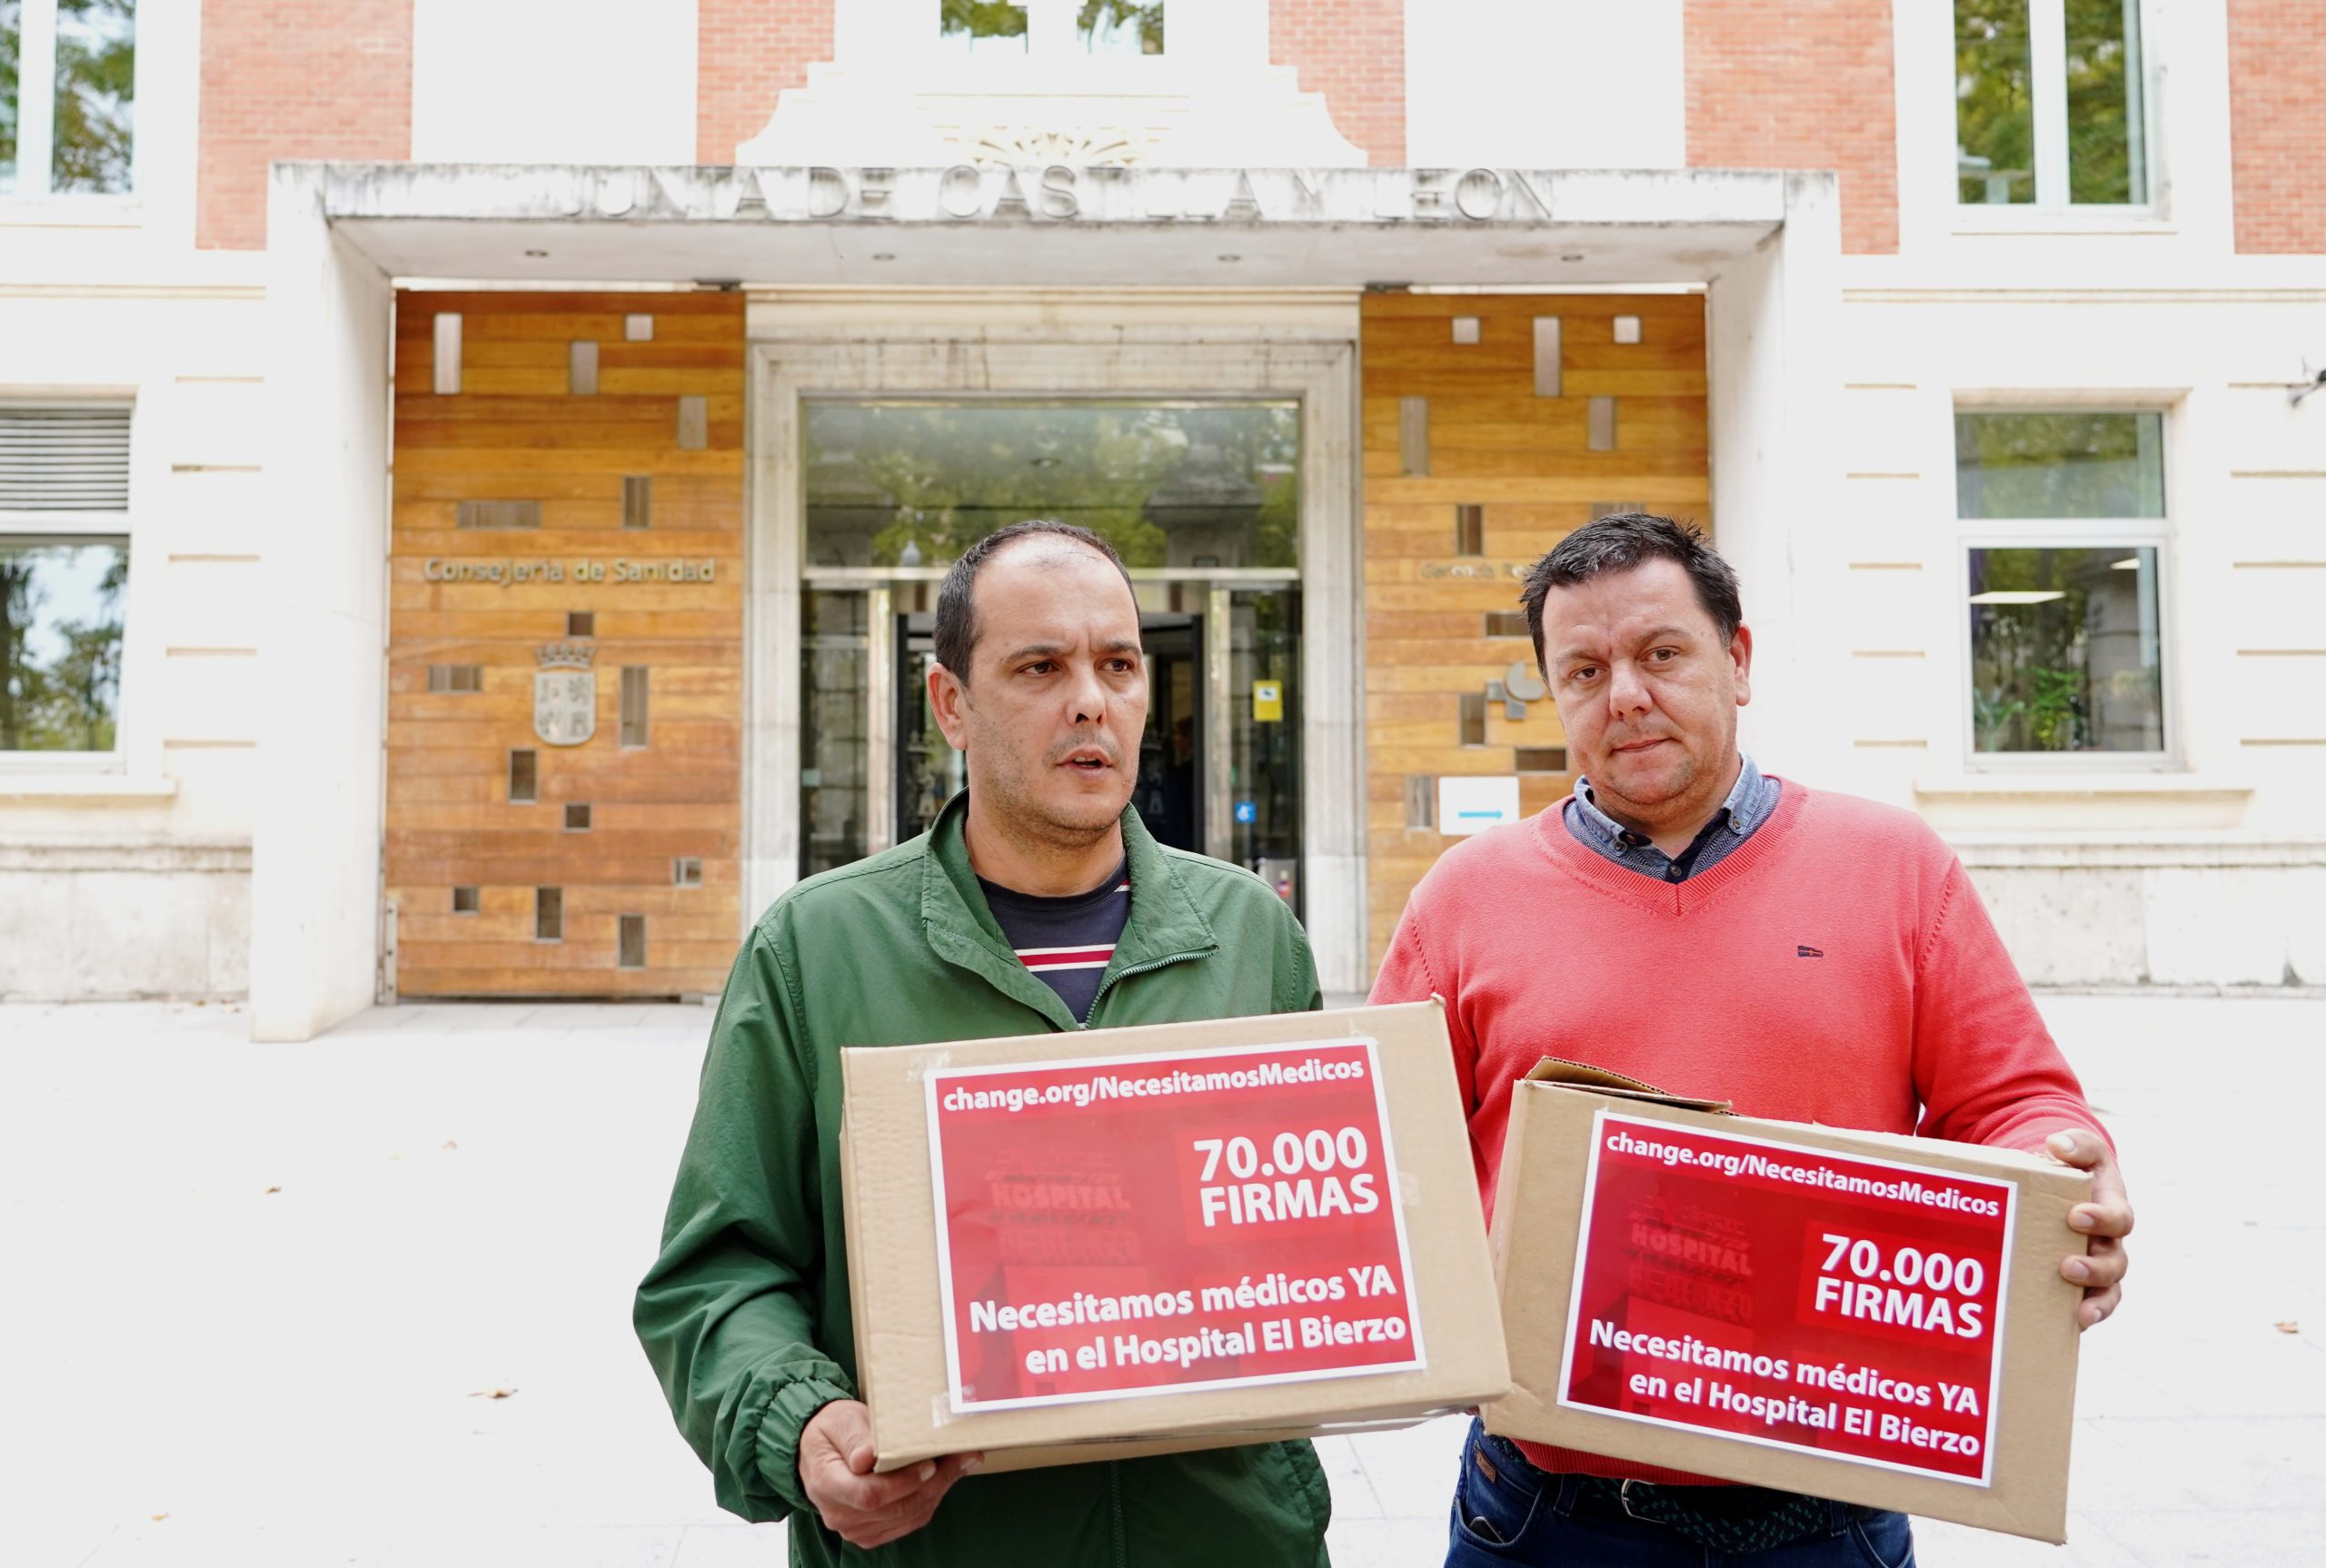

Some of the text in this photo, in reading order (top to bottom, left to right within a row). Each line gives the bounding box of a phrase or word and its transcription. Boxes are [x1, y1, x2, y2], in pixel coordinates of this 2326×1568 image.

[805, 165, 894, 219] DE
[573, 557, 605, 582] de
[612, 557, 715, 583] Sanidad
[943, 1058, 1365, 1113] change.org/NecesitamosMedicos
[1193, 1126, 1368, 1182] 70.000
[1606, 1131, 1999, 1216] change.org/NecesitamosMedicos
[989, 1183, 1131, 1210] HOSPITAL
[1199, 1173, 1379, 1227] FIRMAS
[1631, 1222, 1754, 1276] HOSPITAL
[1821, 1233, 1984, 1296] 70.000
[969, 1264, 1397, 1334] Necesitamos médicos YA
[1815, 1276, 1983, 1338] FIRMAS
[1025, 1315, 1407, 1374] en el Hospital El Bierzo
[1589, 1318, 1979, 1415] Necesitamos médicos YA
[1629, 1374, 1980, 1455] en el Hospital El Bierzo
